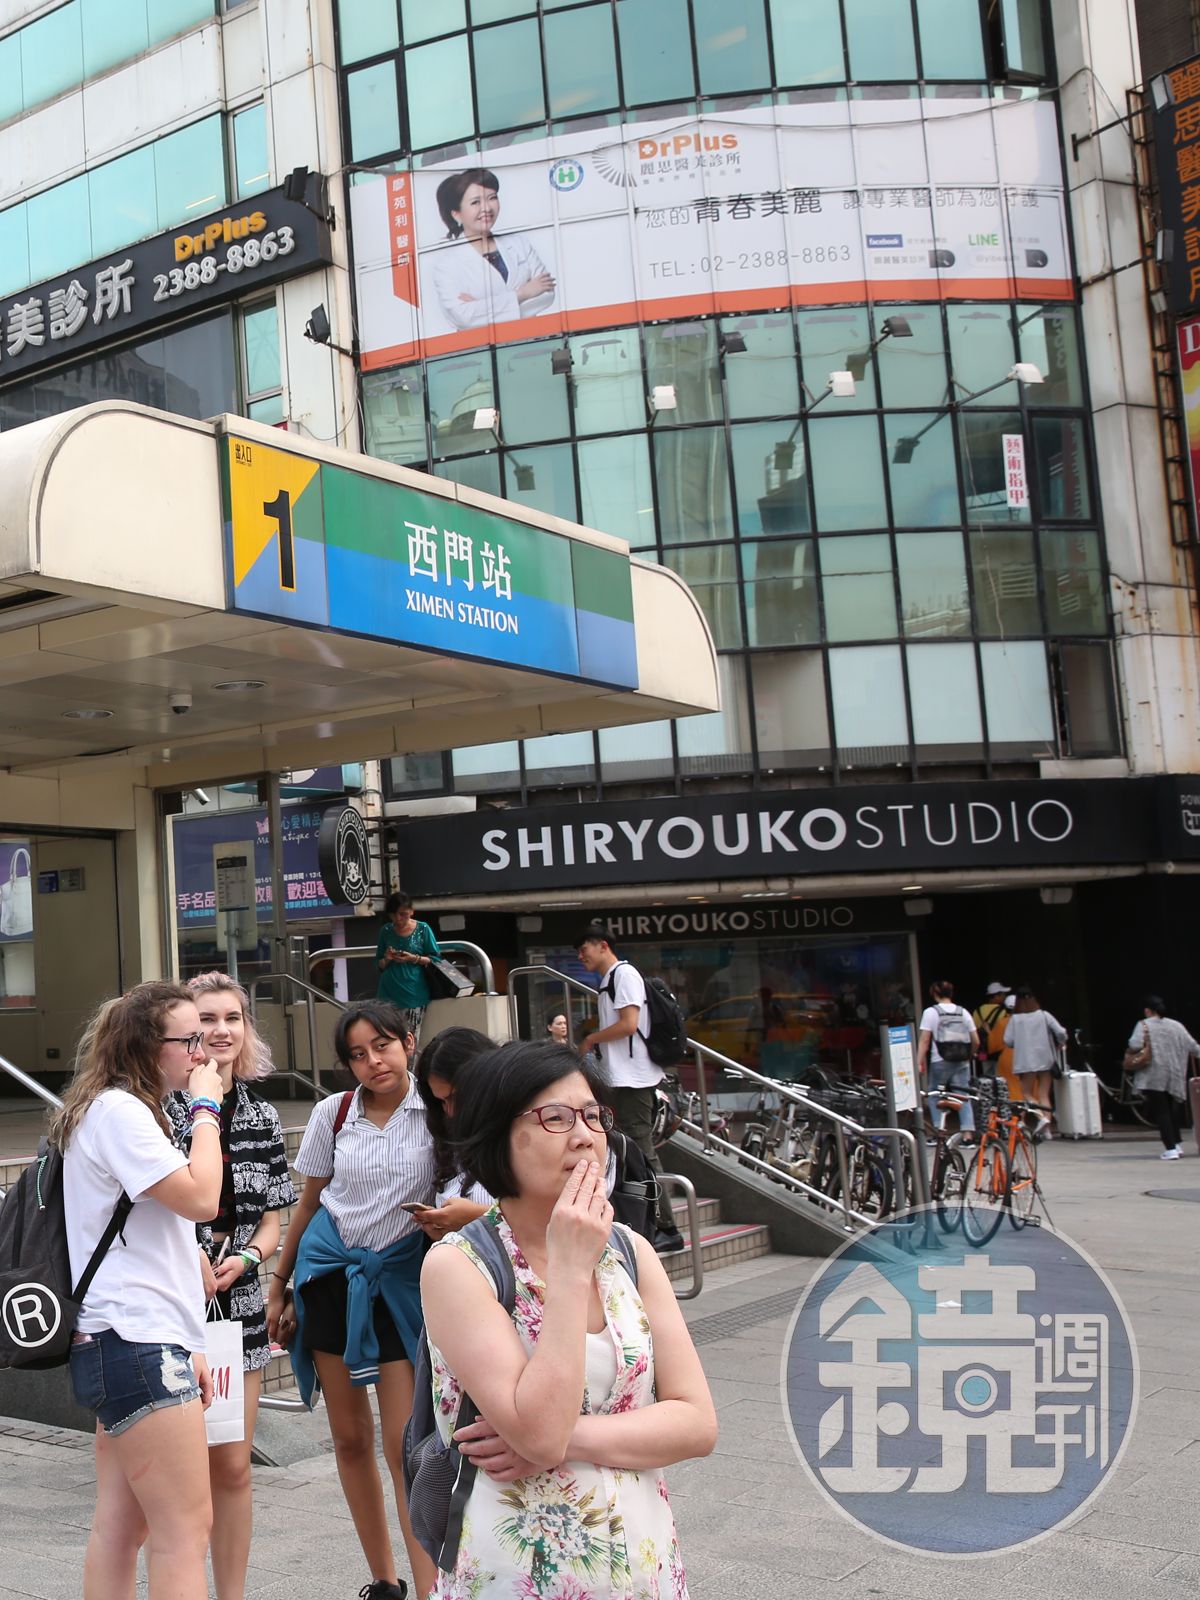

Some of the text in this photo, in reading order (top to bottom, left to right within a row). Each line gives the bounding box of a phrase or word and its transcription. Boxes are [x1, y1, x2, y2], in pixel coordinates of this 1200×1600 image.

[639, 133, 738, 160] DrPlus
[174, 209, 267, 263] DrPlus
[968, 233, 999, 246] LINE
[152, 226, 296, 302] 2388-8863
[235, 443, 252, 463] 出入口
[263, 489, 296, 592] 1
[404, 521, 512, 601] 西門站
[405, 588, 519, 635] XIMEN STATION
